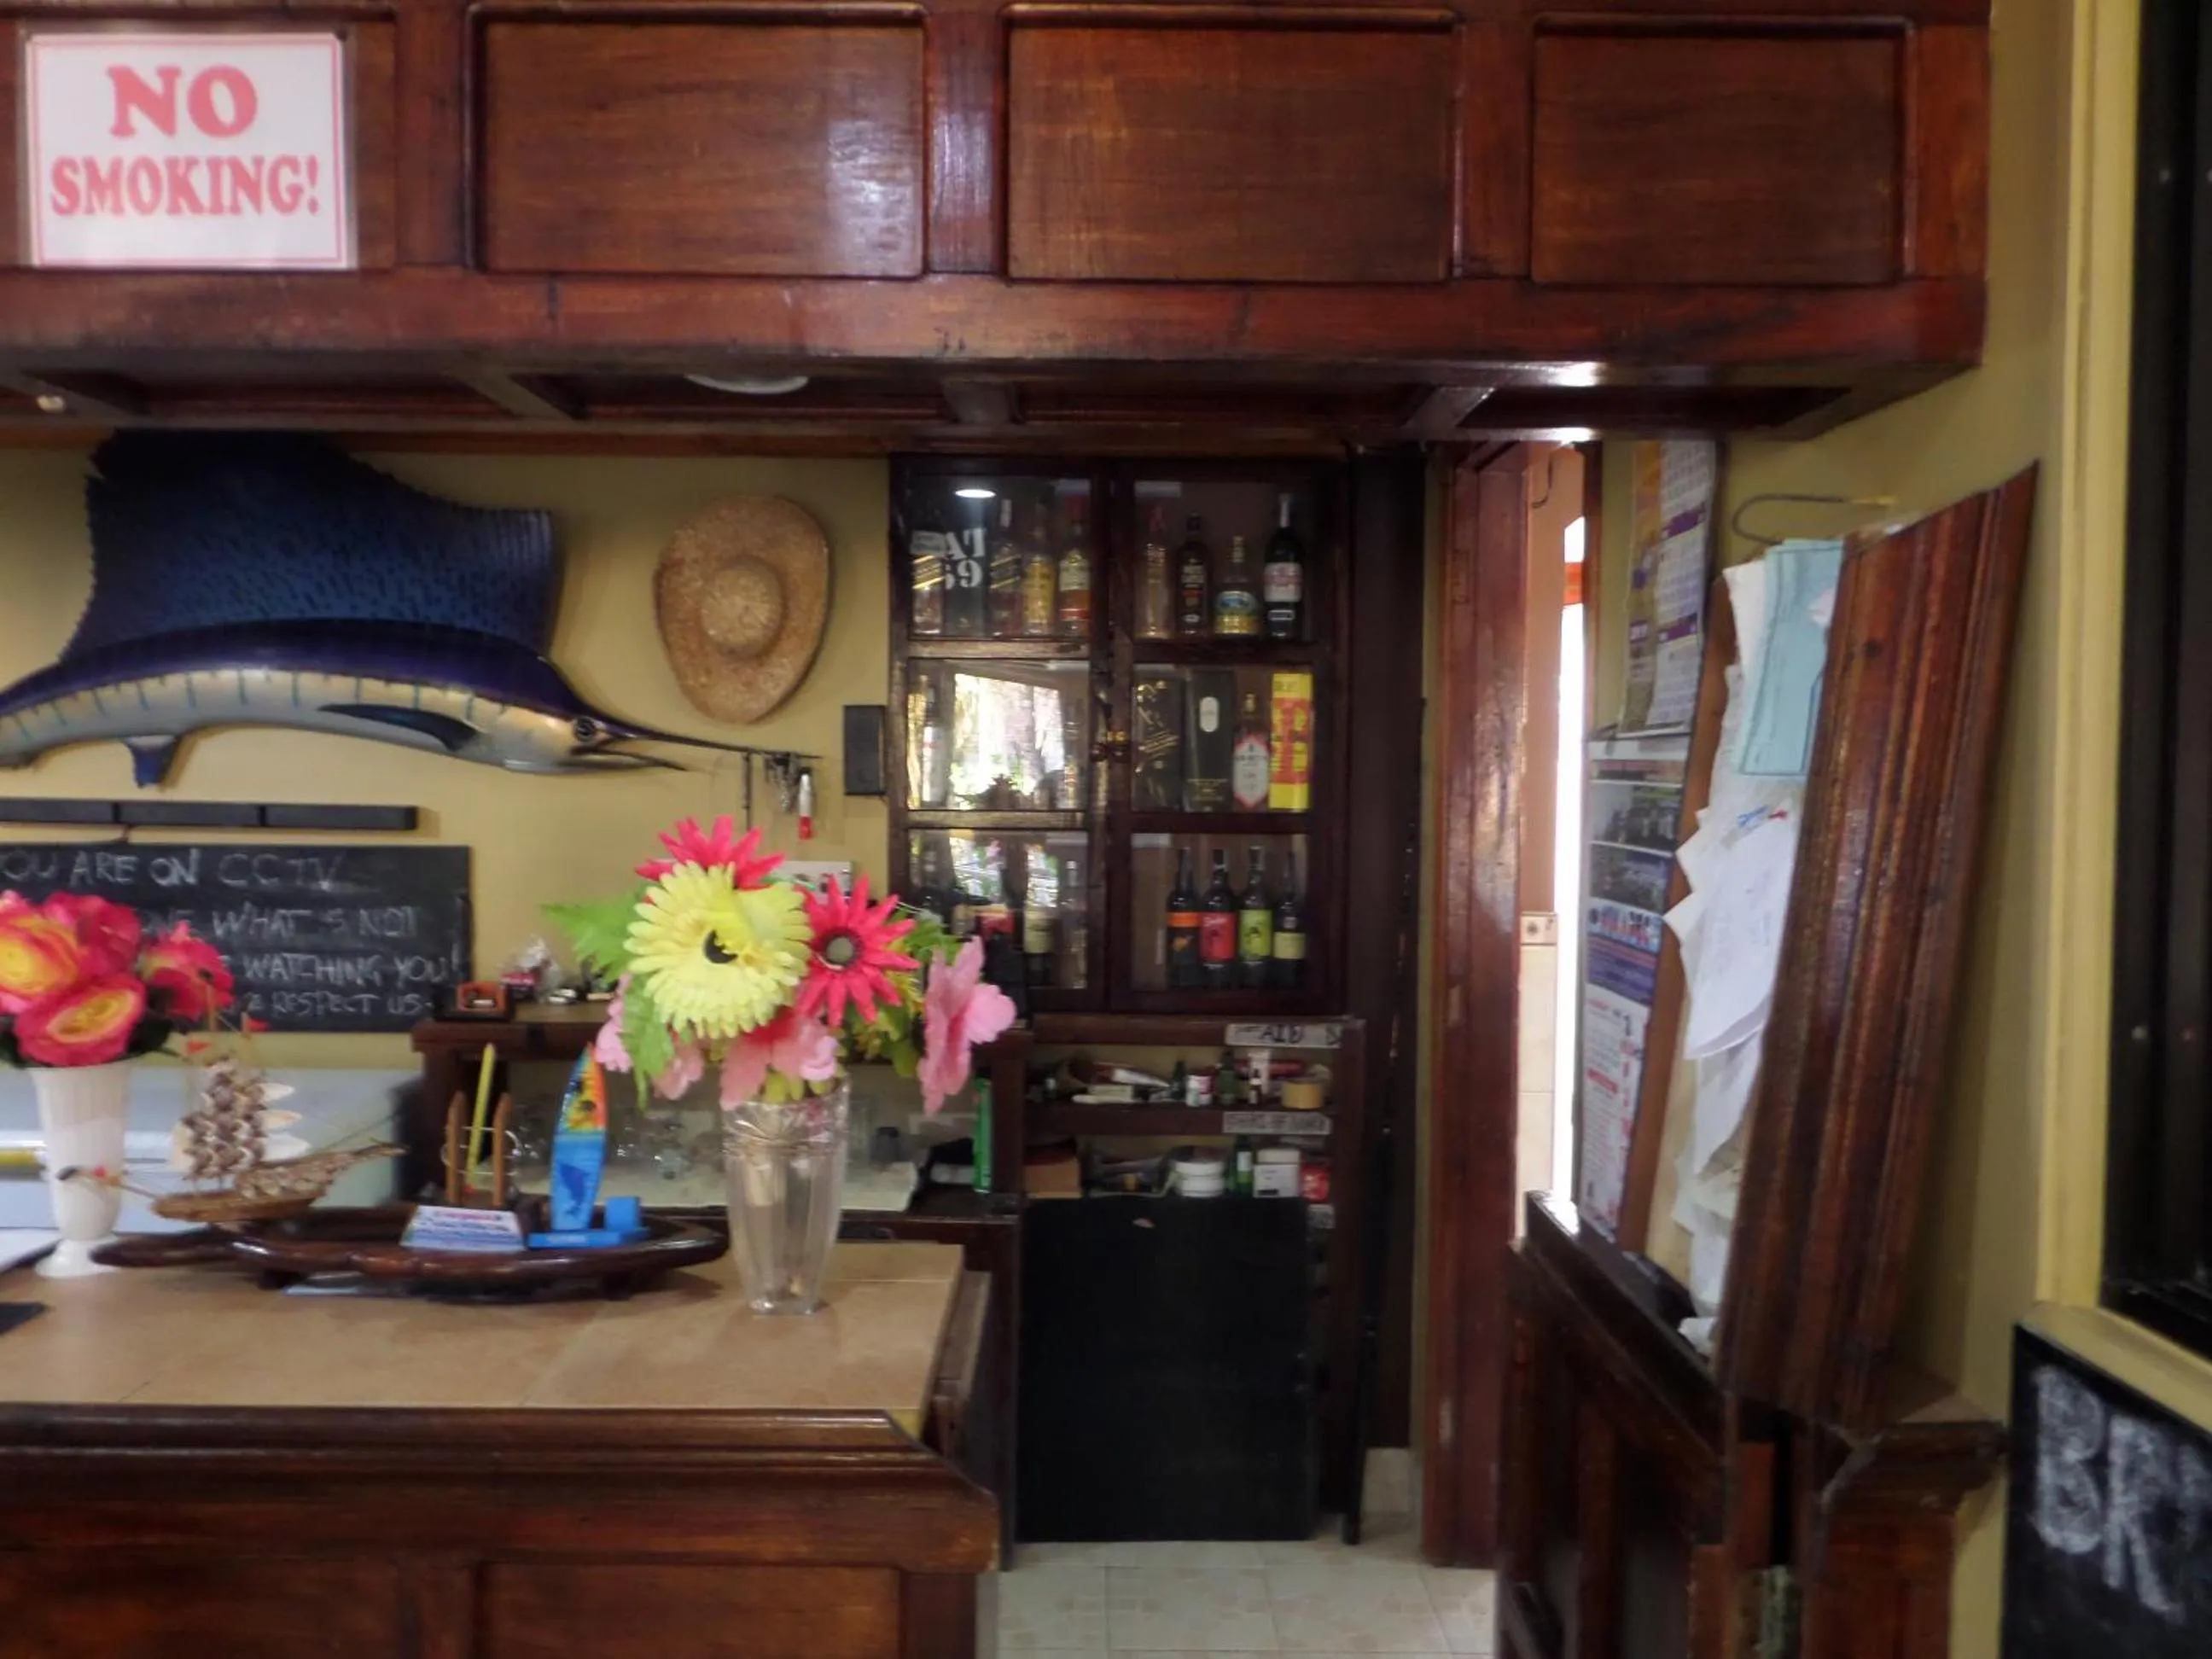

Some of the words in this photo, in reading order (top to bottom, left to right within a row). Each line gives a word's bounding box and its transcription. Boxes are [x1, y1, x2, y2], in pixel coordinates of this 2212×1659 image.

[106, 65, 258, 138] NO
[51, 154, 319, 216] SMOKING!
[0, 848, 59, 882] OU
[69, 850, 137, 888] ARE
[149, 848, 200, 887] ON
[212, 901, 311, 940] WHAT
[243, 952, 382, 987] WATCHING
[271, 990, 381, 1016] RESPECT
